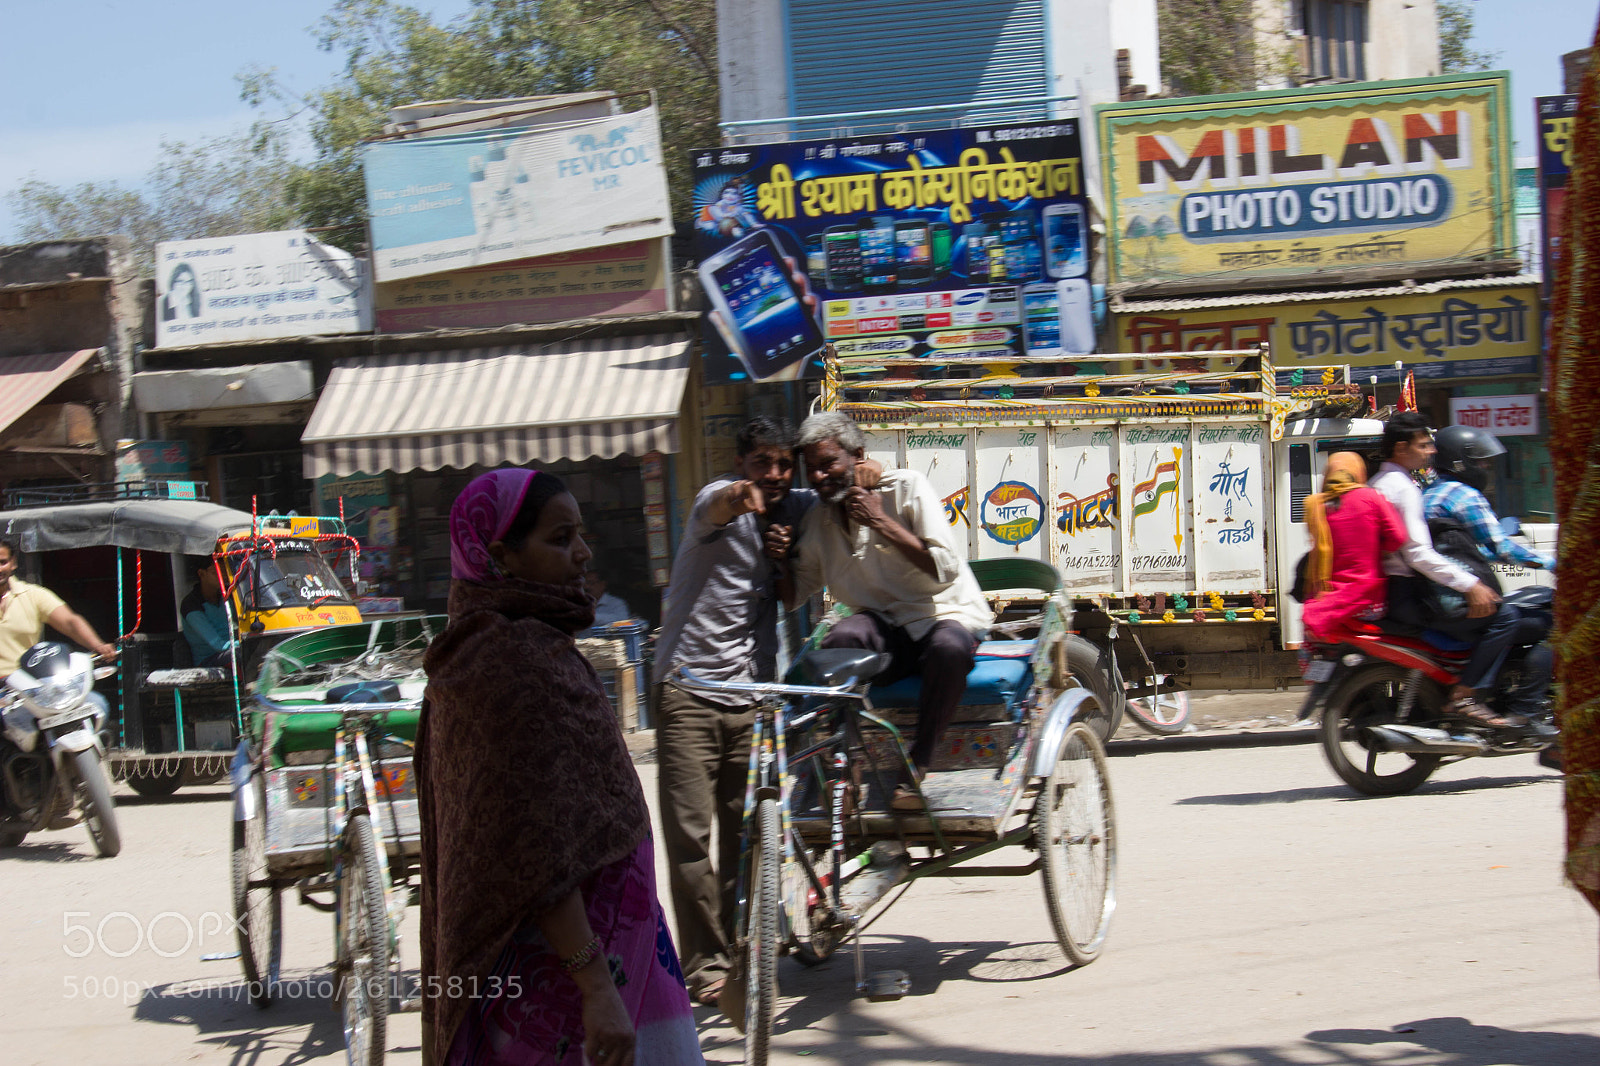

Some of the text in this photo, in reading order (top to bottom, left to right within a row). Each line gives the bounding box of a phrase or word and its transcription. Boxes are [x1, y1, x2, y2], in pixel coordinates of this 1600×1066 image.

[1135, 110, 1472, 191] MILAN
[557, 144, 650, 178] FEVICOL
[592, 174, 622, 192] MR
[757, 163, 796, 220] श्री
[800, 174, 877, 217] श्याम
[1186, 187, 1300, 233] PHOTO
[1309, 178, 1440, 225] STUDIO
[859, 316, 898, 333] INTEX
[177, 490, 195, 498] EXPRESS
[998, 484, 1024, 502] मेरा
[1209, 462, 1253, 507] गोलू
[996, 504, 1031, 521] भारत
[996, 520, 1035, 541] महान
[1489, 564, 1524, 573] OLERO
